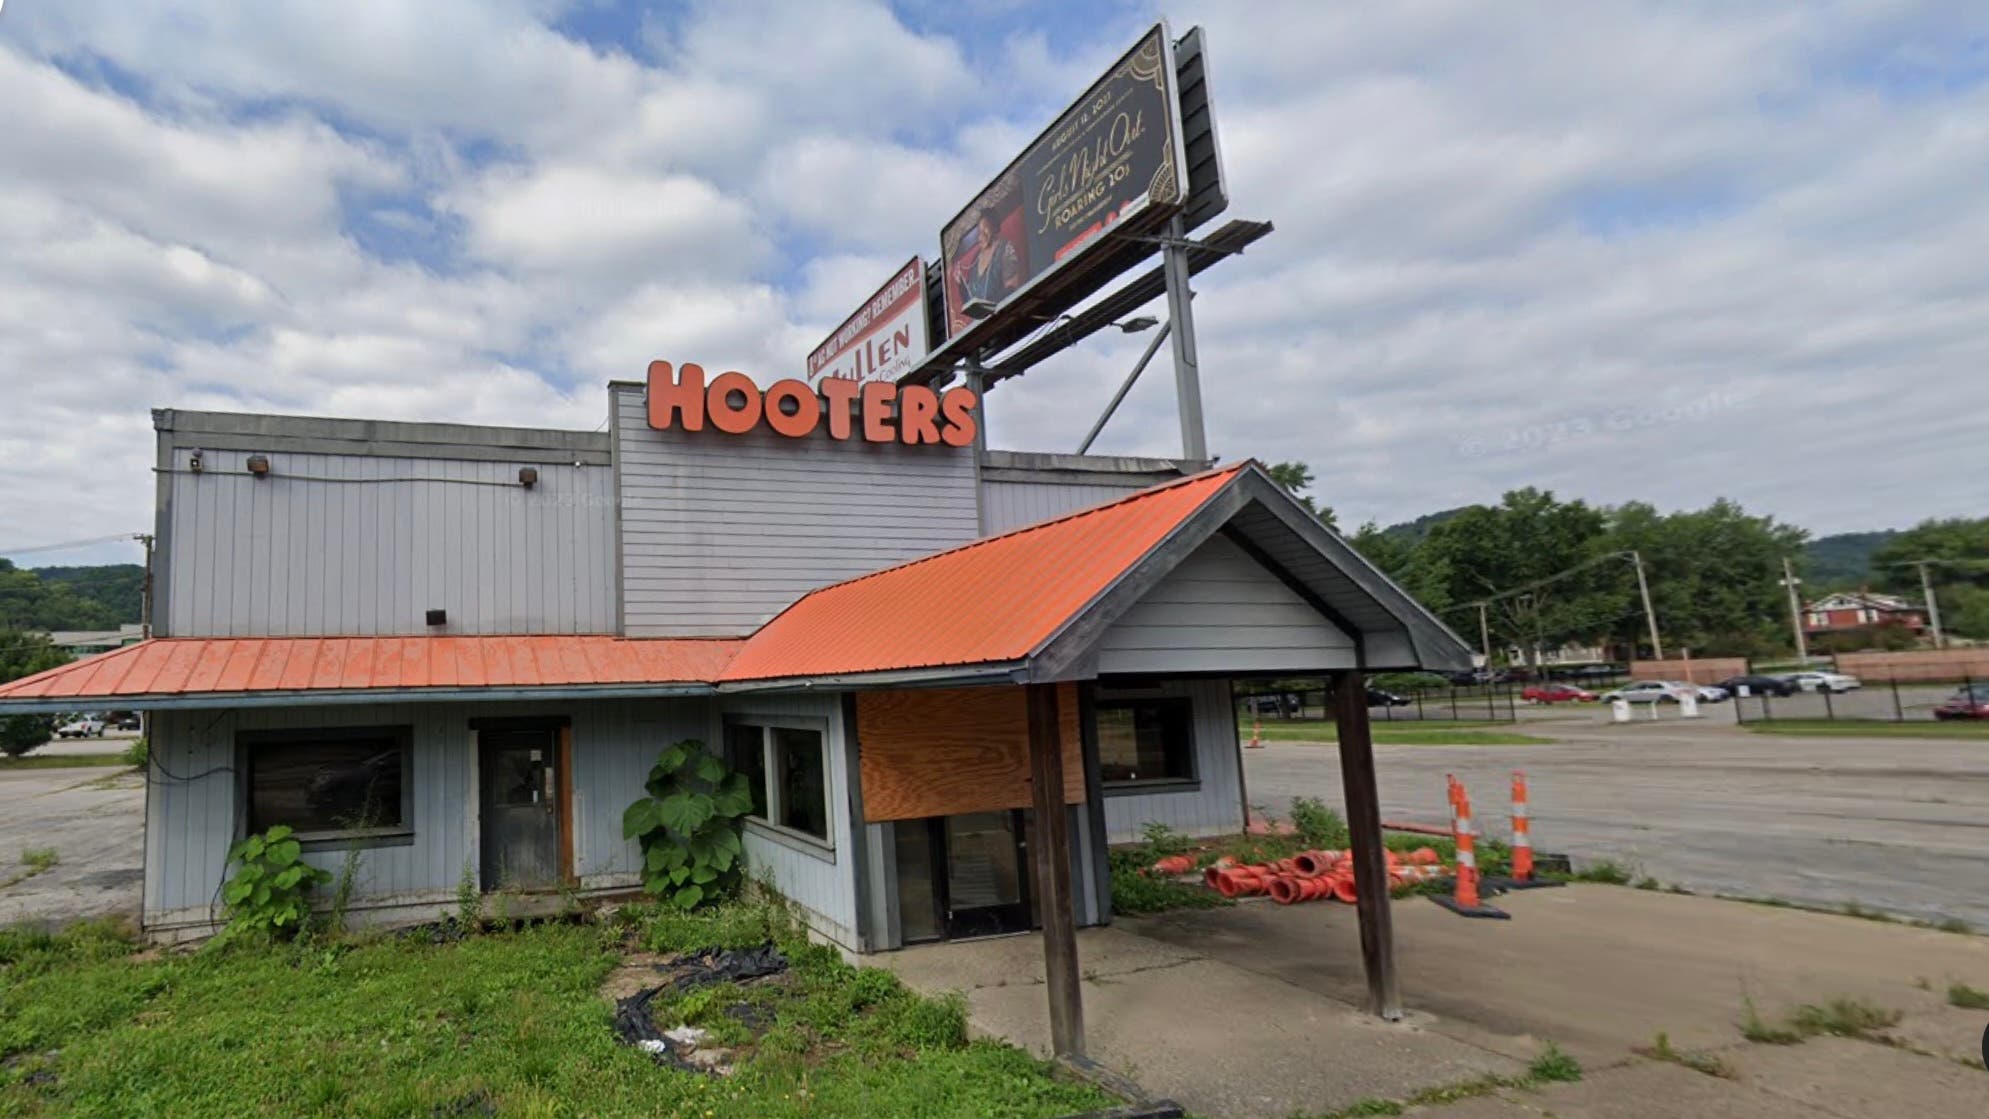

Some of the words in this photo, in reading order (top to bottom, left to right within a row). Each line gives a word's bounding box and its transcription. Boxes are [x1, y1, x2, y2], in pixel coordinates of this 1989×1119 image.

[1055, 181, 1105, 230] ROARING
[833, 323, 910, 381] LLEN
[647, 360, 978, 448] HOOTERS
